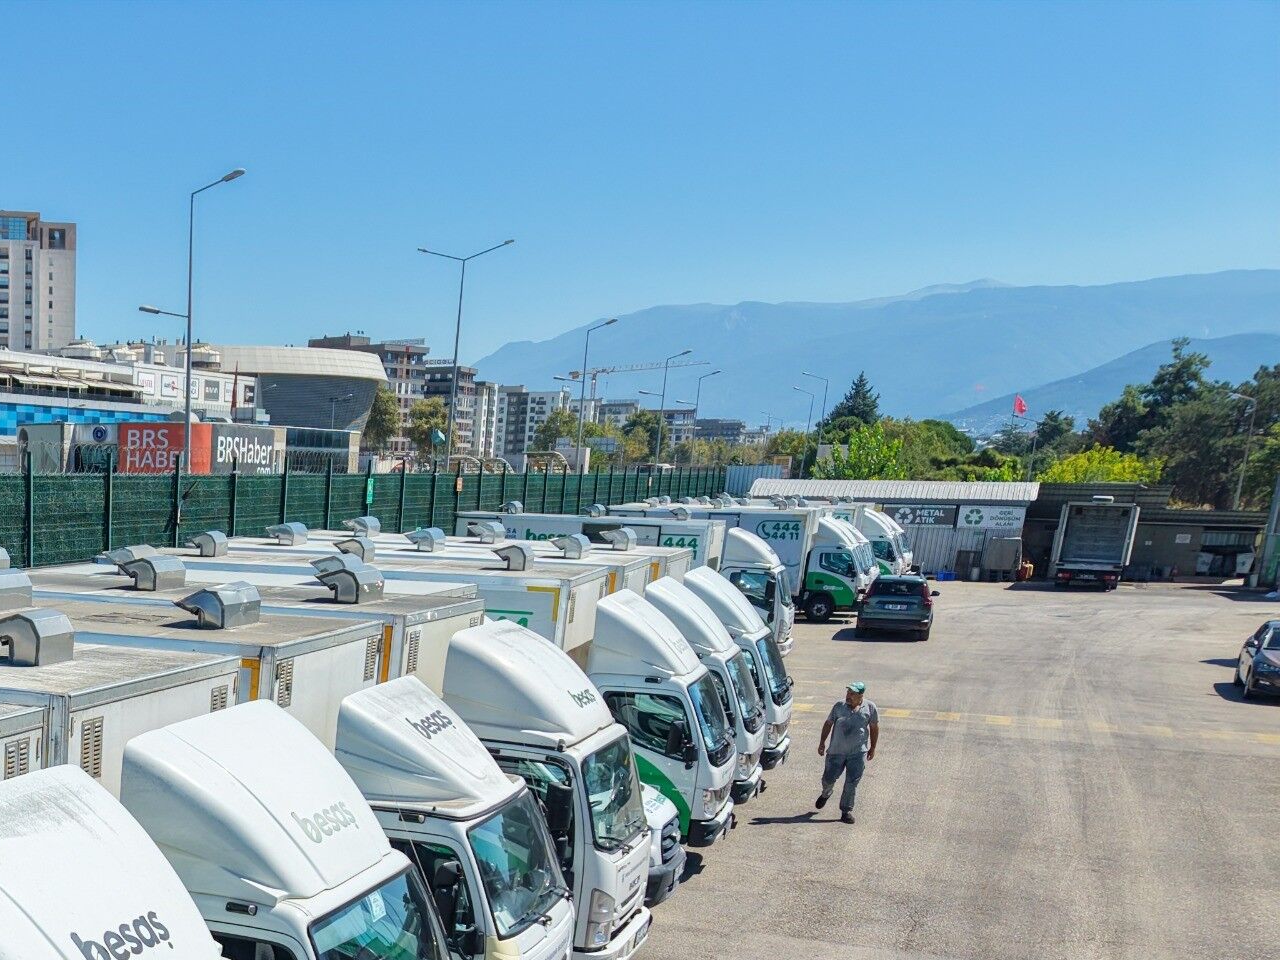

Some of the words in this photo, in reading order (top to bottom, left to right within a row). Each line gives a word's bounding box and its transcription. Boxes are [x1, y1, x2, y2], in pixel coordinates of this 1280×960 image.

[127, 429, 169, 449] BRS
[216, 435, 272, 465] BRSHaber
[915, 509, 945, 517] METAL
[914, 516, 935, 524] ATIK
[772, 522, 800, 531] 444
